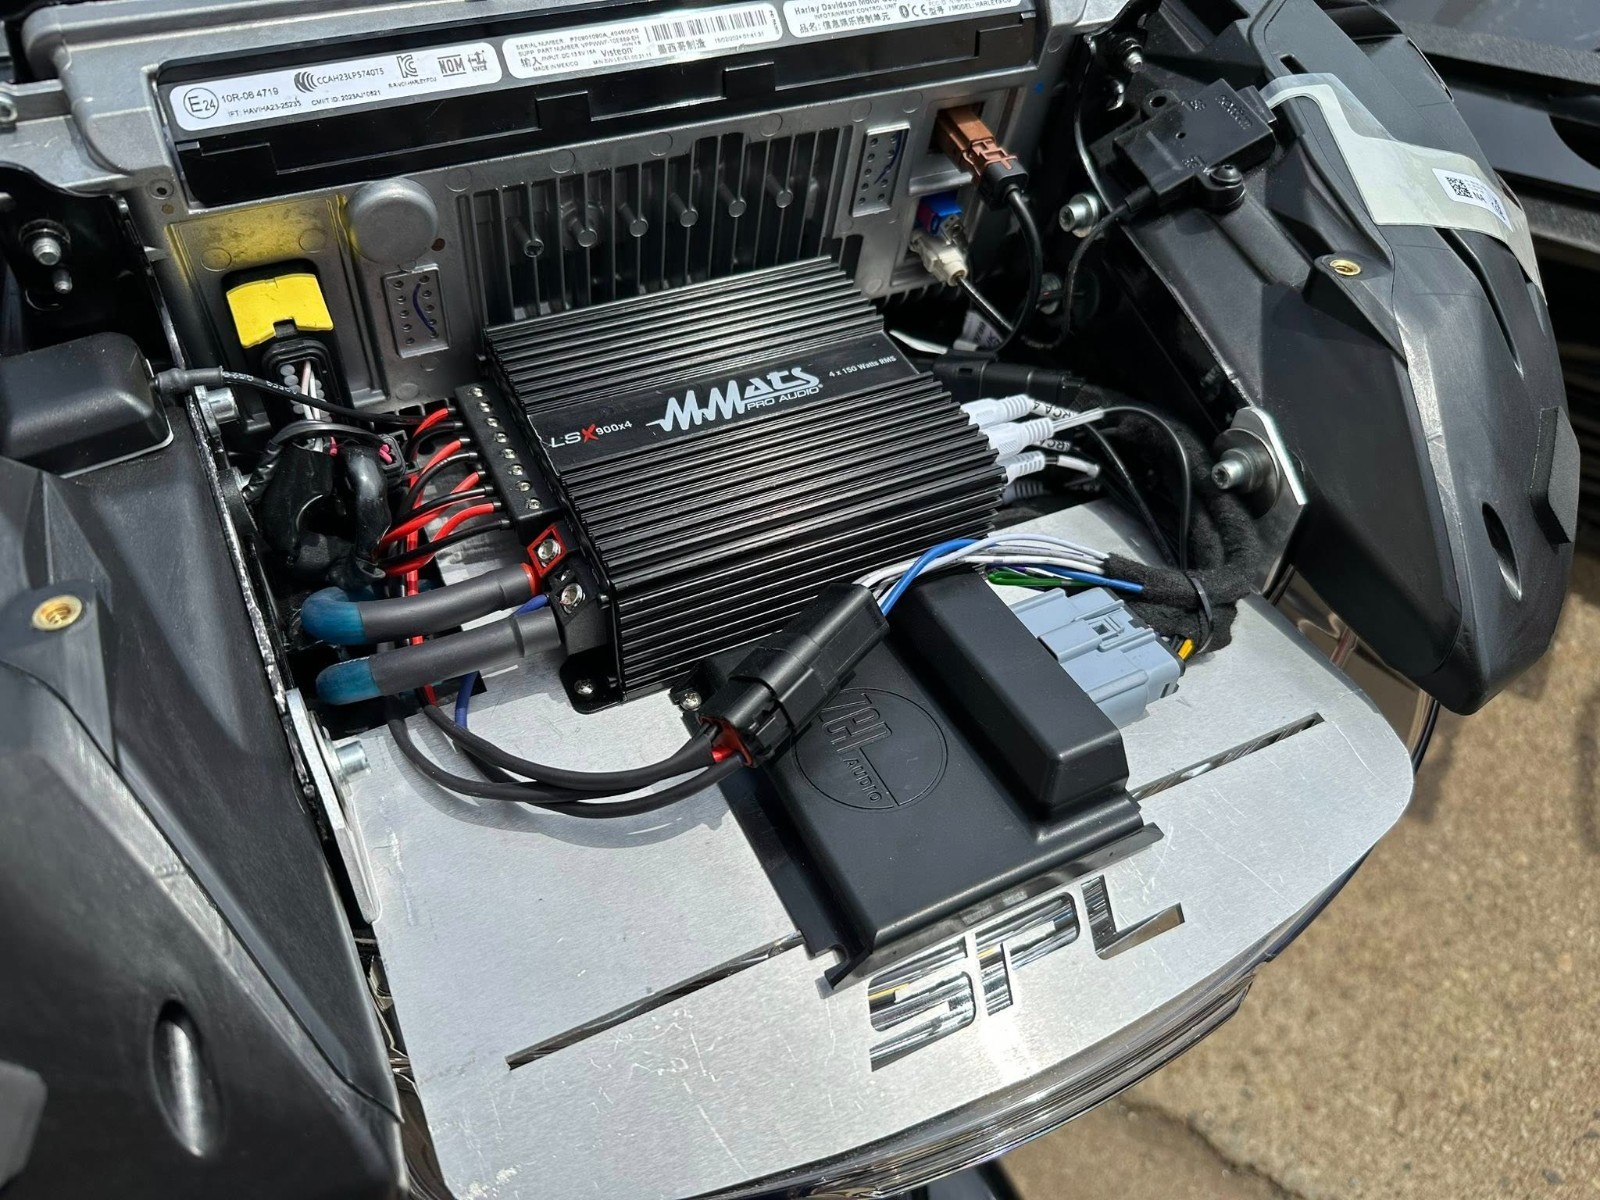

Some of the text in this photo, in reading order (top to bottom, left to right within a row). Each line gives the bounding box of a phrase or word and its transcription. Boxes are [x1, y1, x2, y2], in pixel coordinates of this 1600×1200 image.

[794, 5, 820, 15] Harley
[821, 1, 858, 11] Davidson
[813, 9, 856, 20] INFOTAINMENT
[856, 5, 883, 14] CONTROL
[884, 2, 897, 10] UNIT
[600, 46, 634, 57] Visteon
[438, 58, 466, 75] NOM
[256, 87, 279, 99] 4719
[842, 365, 858, 375] 150
[857, 360, 880, 371] Watts
[878, 355, 897, 365] RMS
[746, 386, 821, 412] PRO AUDIO
[1045, 404, 1072, 419] RCA
[842, 756, 883, 803] AUDIO
[868, 874, 1186, 1072] SPL
